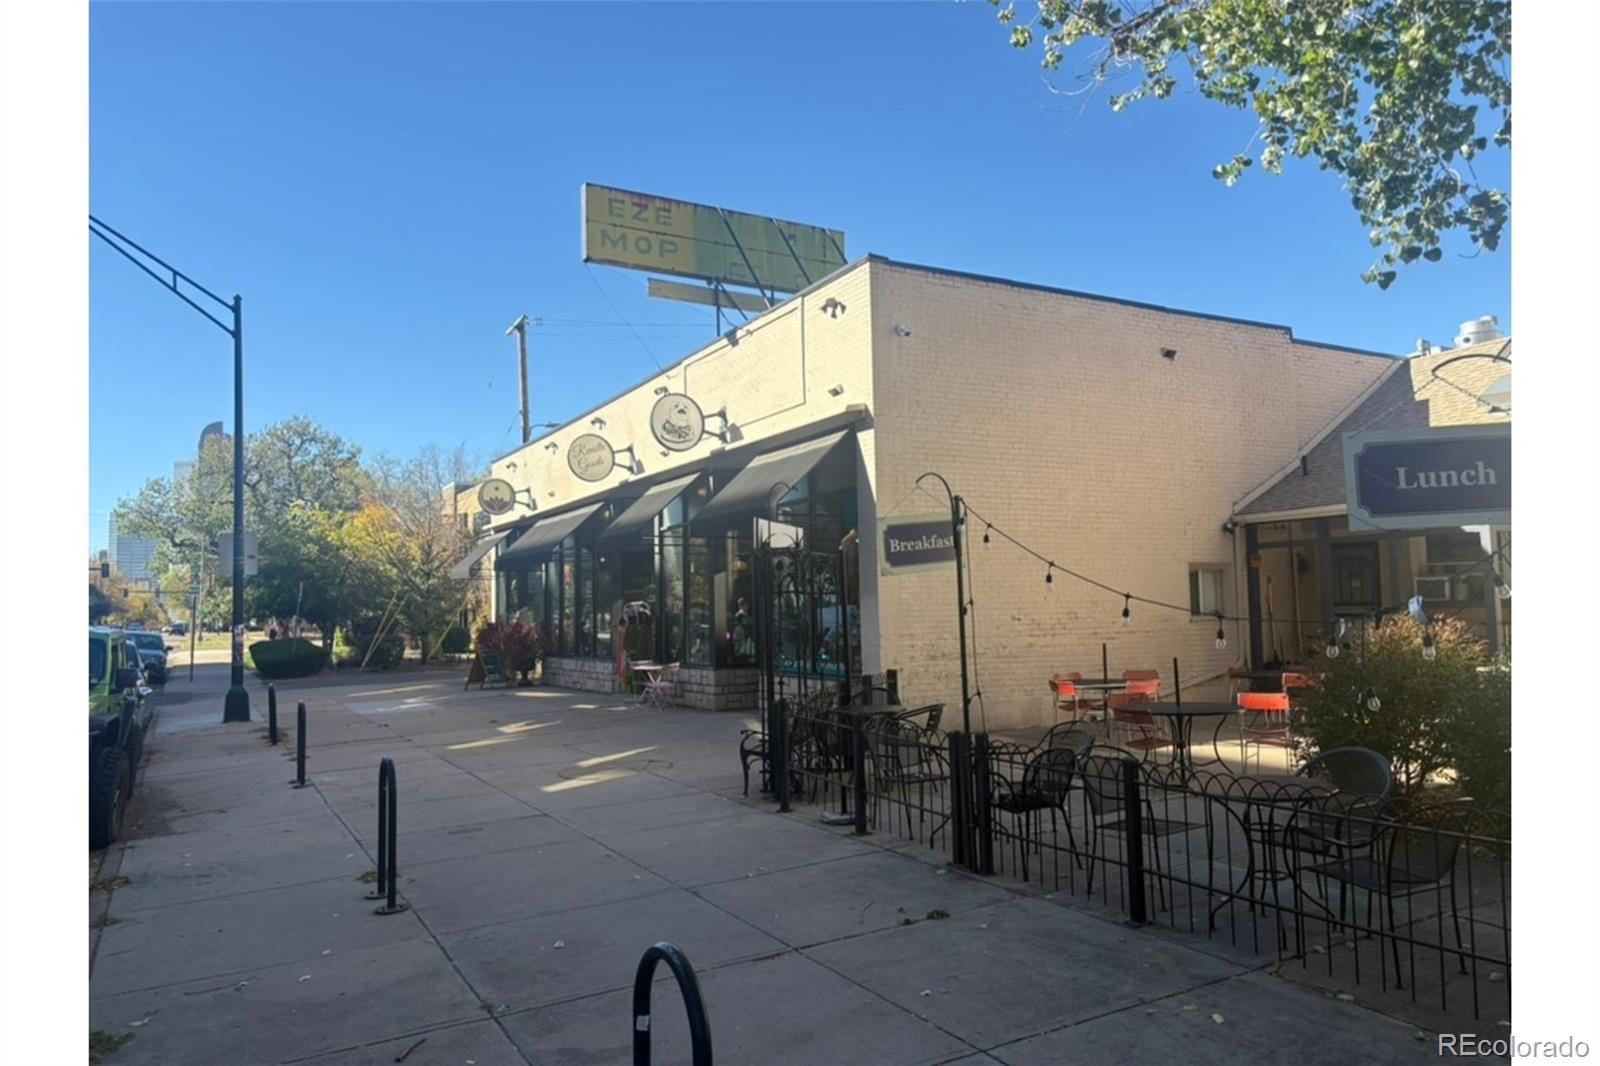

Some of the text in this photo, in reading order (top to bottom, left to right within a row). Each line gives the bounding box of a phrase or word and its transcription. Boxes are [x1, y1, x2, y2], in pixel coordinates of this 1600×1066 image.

[607, 197, 673, 228] EZE
[600, 229, 679, 258] MOP
[1395, 461, 1498, 490] Lunch
[889, 534, 954, 553] Breakfast
